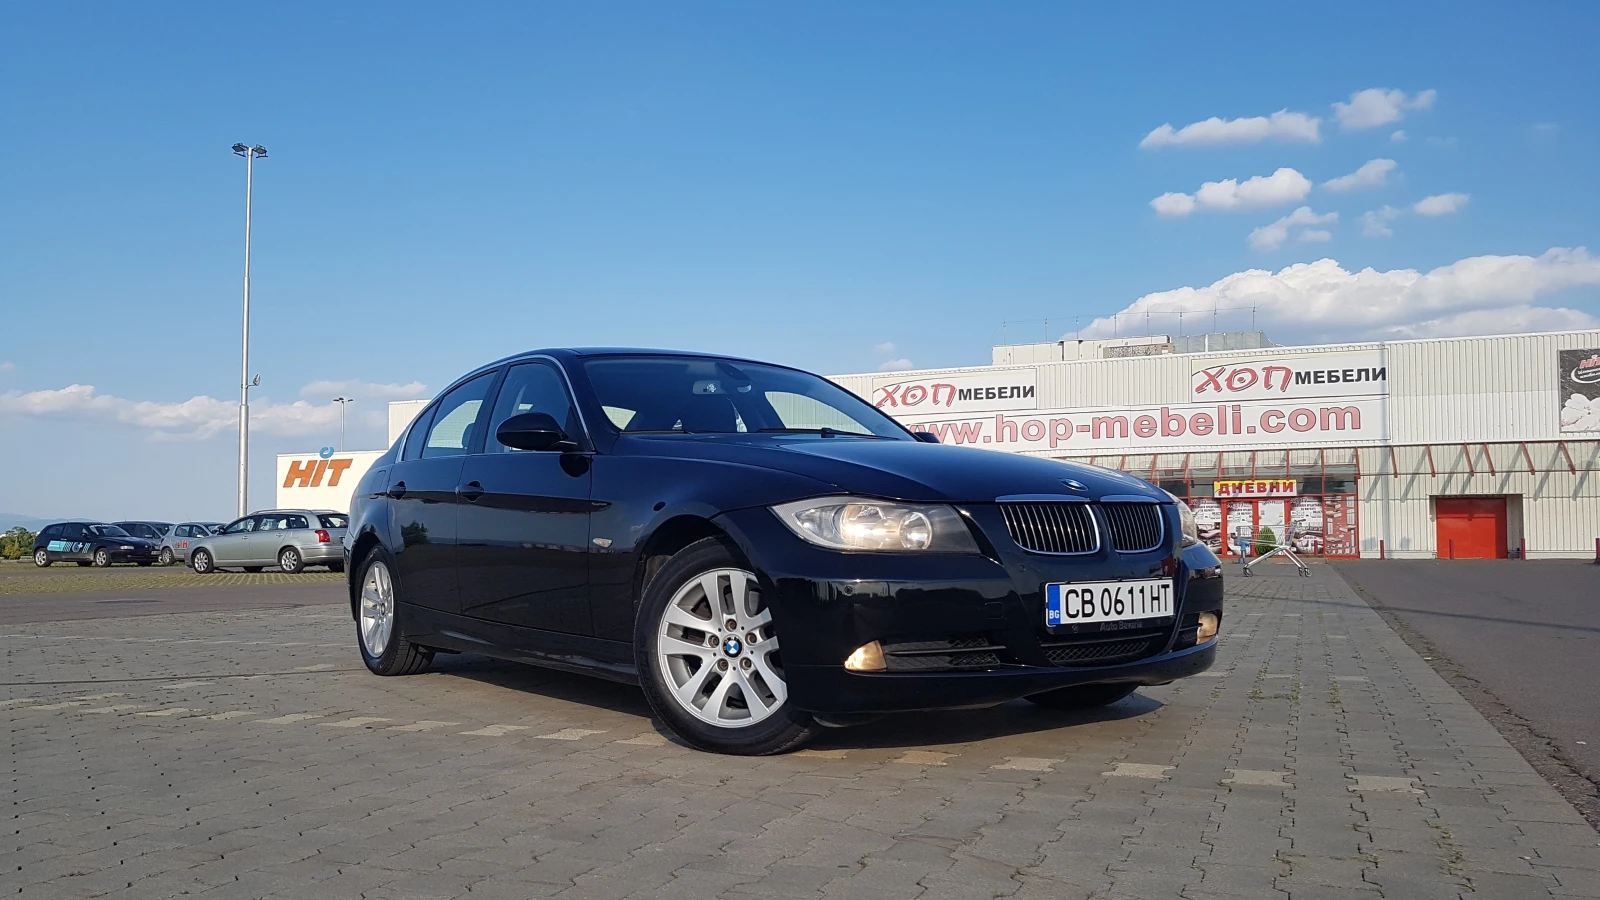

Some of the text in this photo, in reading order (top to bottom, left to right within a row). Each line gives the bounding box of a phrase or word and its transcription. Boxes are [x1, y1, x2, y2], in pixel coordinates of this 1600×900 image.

[1294, 367, 1386, 385] МЕБЕЛИ
[958, 385, 1035, 401] МЕБЕЛИ
[909, 405, 1361, 448] ww.hop-mebeli.com
[282, 458, 353, 488] HIT
[1218, 481, 1294, 496] ДНЕВНИ
[1049, 610, 1060, 619] BG
[1100, 622, 1118, 631] Auto
